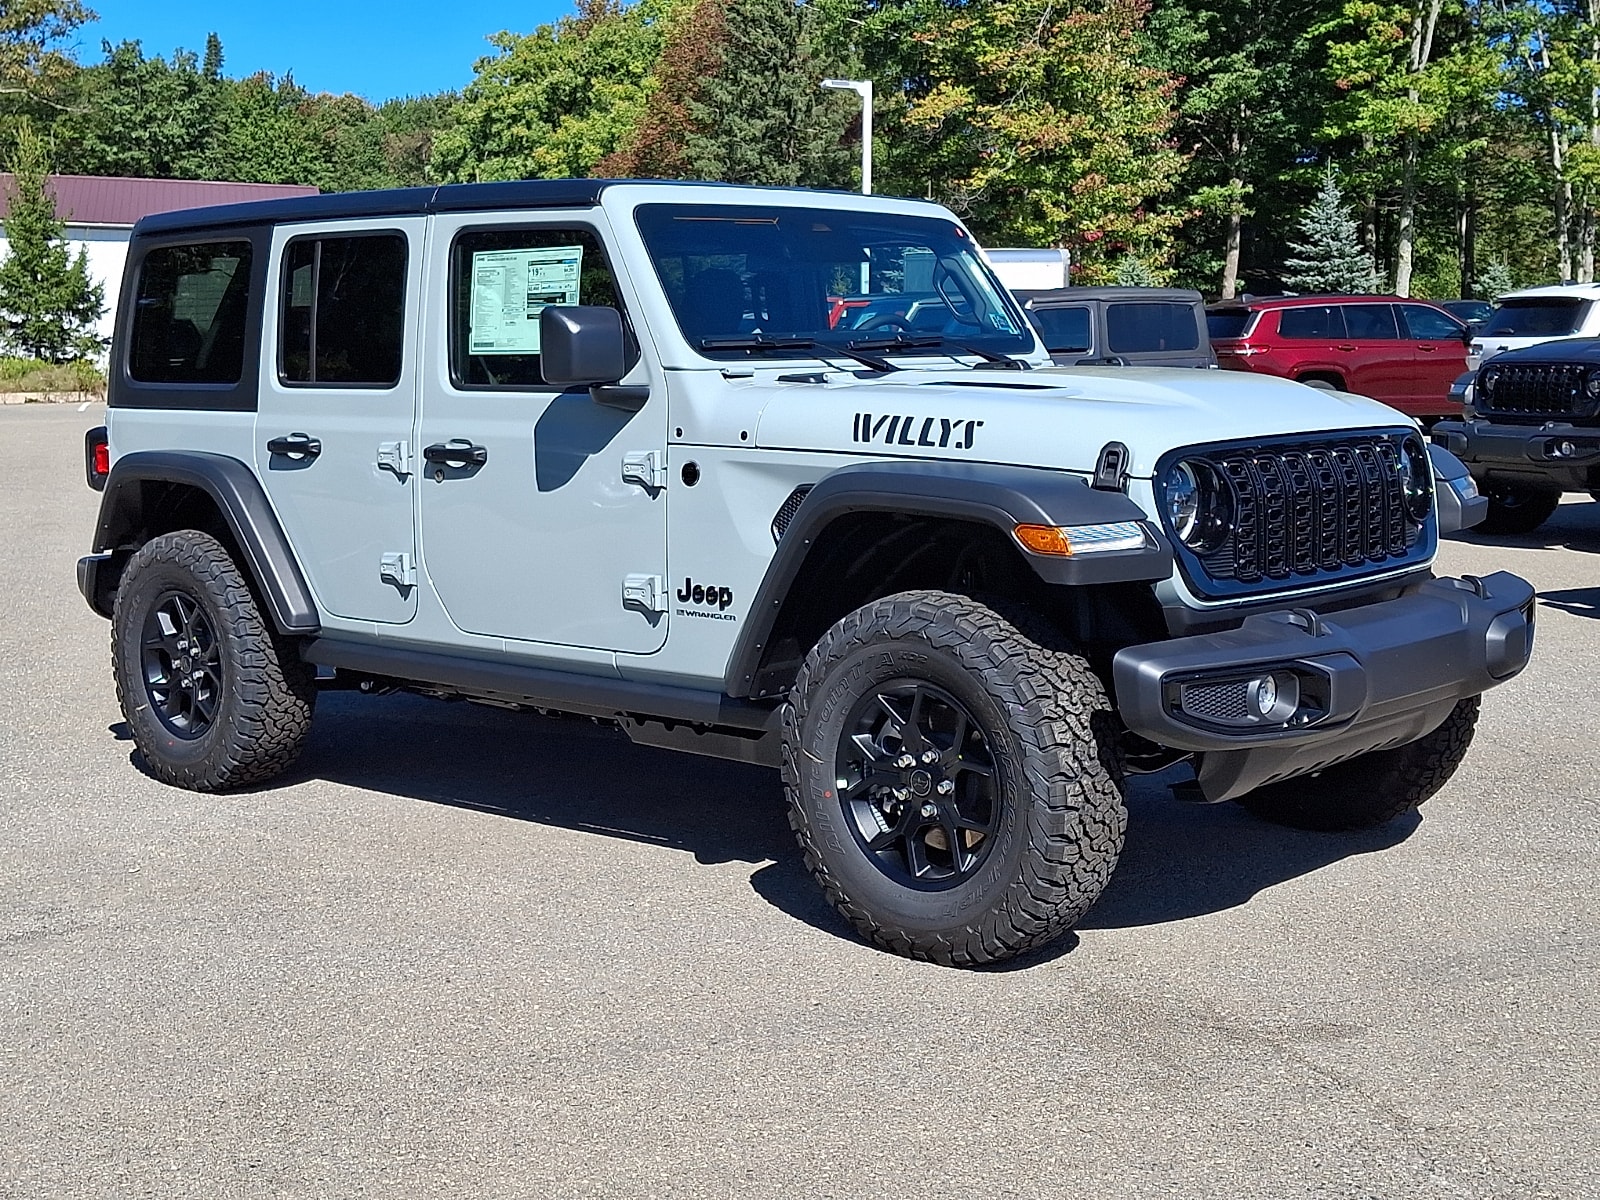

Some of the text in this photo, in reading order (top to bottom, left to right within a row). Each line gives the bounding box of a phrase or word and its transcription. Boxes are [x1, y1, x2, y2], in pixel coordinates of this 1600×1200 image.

[853, 413, 984, 449] WILLYS
[677, 577, 733, 611] Jeep
[685, 609, 737, 622] WRANGLER
